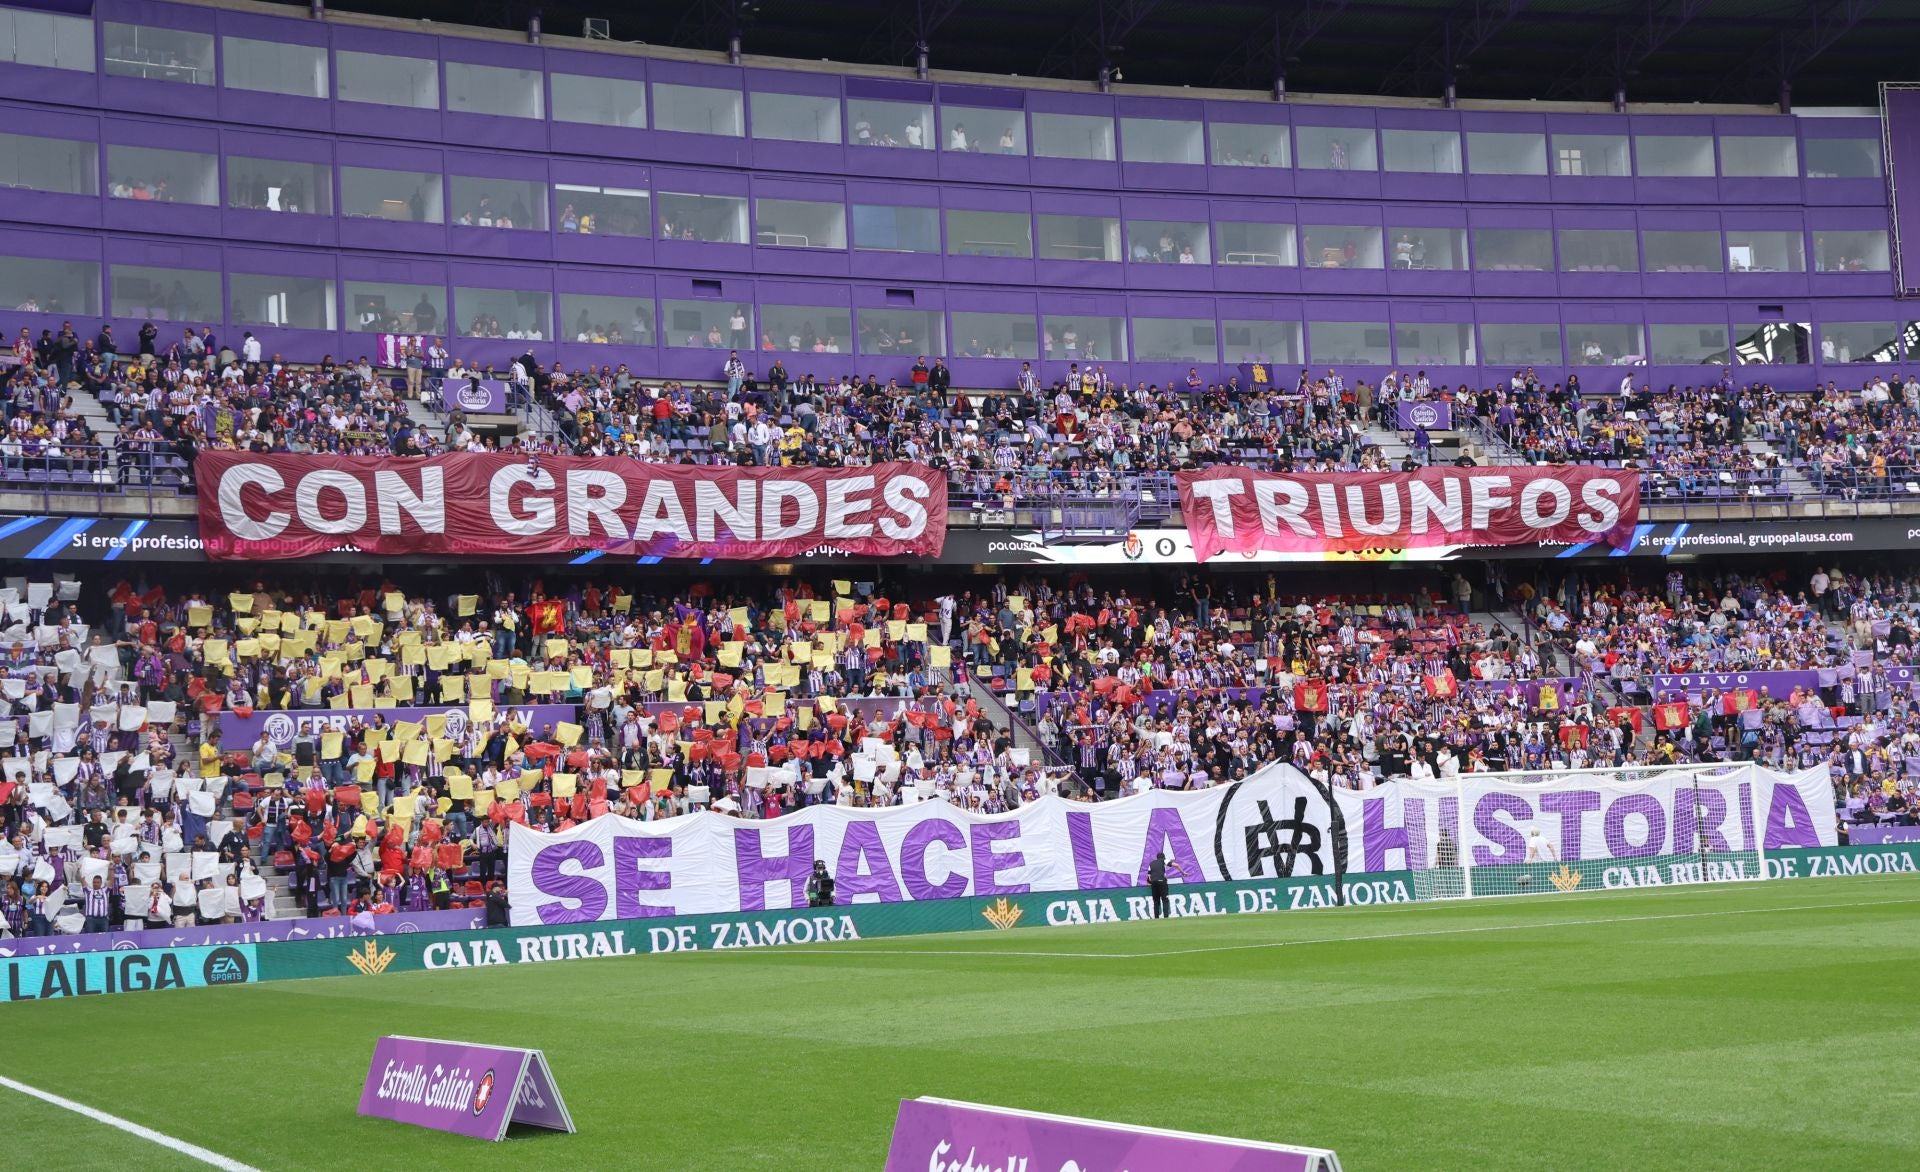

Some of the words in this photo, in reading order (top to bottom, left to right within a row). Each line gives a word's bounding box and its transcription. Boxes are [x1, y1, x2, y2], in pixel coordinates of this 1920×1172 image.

[218, 463, 446, 541] CON
[490, 464, 931, 542] GRANDES
[1193, 476, 1621, 539] TRIUNFOS
[72, 532, 87, 548] Si
[91, 535, 128, 549] eres
[988, 541, 1038, 553] palausa
[1639, 534, 1650, 546] Si
[1652, 536, 1677, 546] eres
[1679, 532, 1747, 548] profesional,
[1748, 531, 1854, 547] grupopalausa.com
[1659, 674, 1748, 687] VOLVO
[531, 836, 676, 925] SE
[734, 818, 1031, 913] HACE
[1066, 808, 1206, 891] LA
[1363, 783, 1821, 873] HISTORIA
[1764, 857, 1799, 880] DE
[1807, 851, 1917, 878] ZAMORA
[1236, 888, 1279, 914] DE
[1287, 879, 1410, 910] ZAMORA
[517, 929, 637, 964] RURAL
[649, 925, 699, 954] DE
[711, 915, 861, 950] ZAMORA
[8, 952, 186, 1001] LALIGA
[210, 972, 242, 982] SPORTS
[211, 957, 241, 973] EA
[377, 1058, 427, 1105] Estrella
[424, 1063, 475, 1113] Galicia
